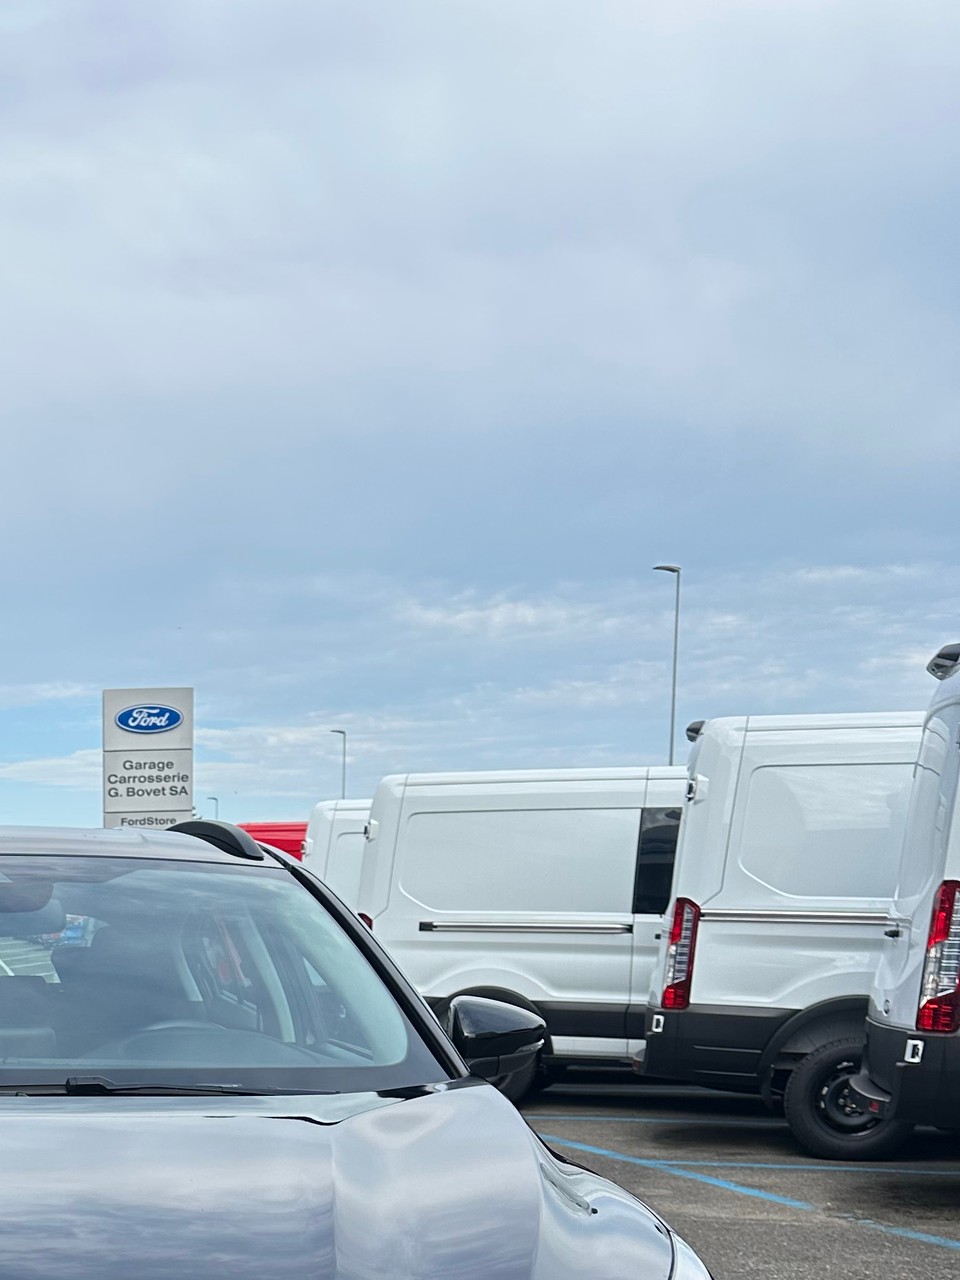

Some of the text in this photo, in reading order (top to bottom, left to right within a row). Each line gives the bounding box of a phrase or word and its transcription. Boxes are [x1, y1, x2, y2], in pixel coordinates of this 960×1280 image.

[128, 708, 169, 726] Ford
[122, 760, 174, 771] Garage
[107, 773, 189, 785] Carrosserie
[108, 785, 189, 797] G. Bovet SA
[121, 816, 177, 826] FordStore
